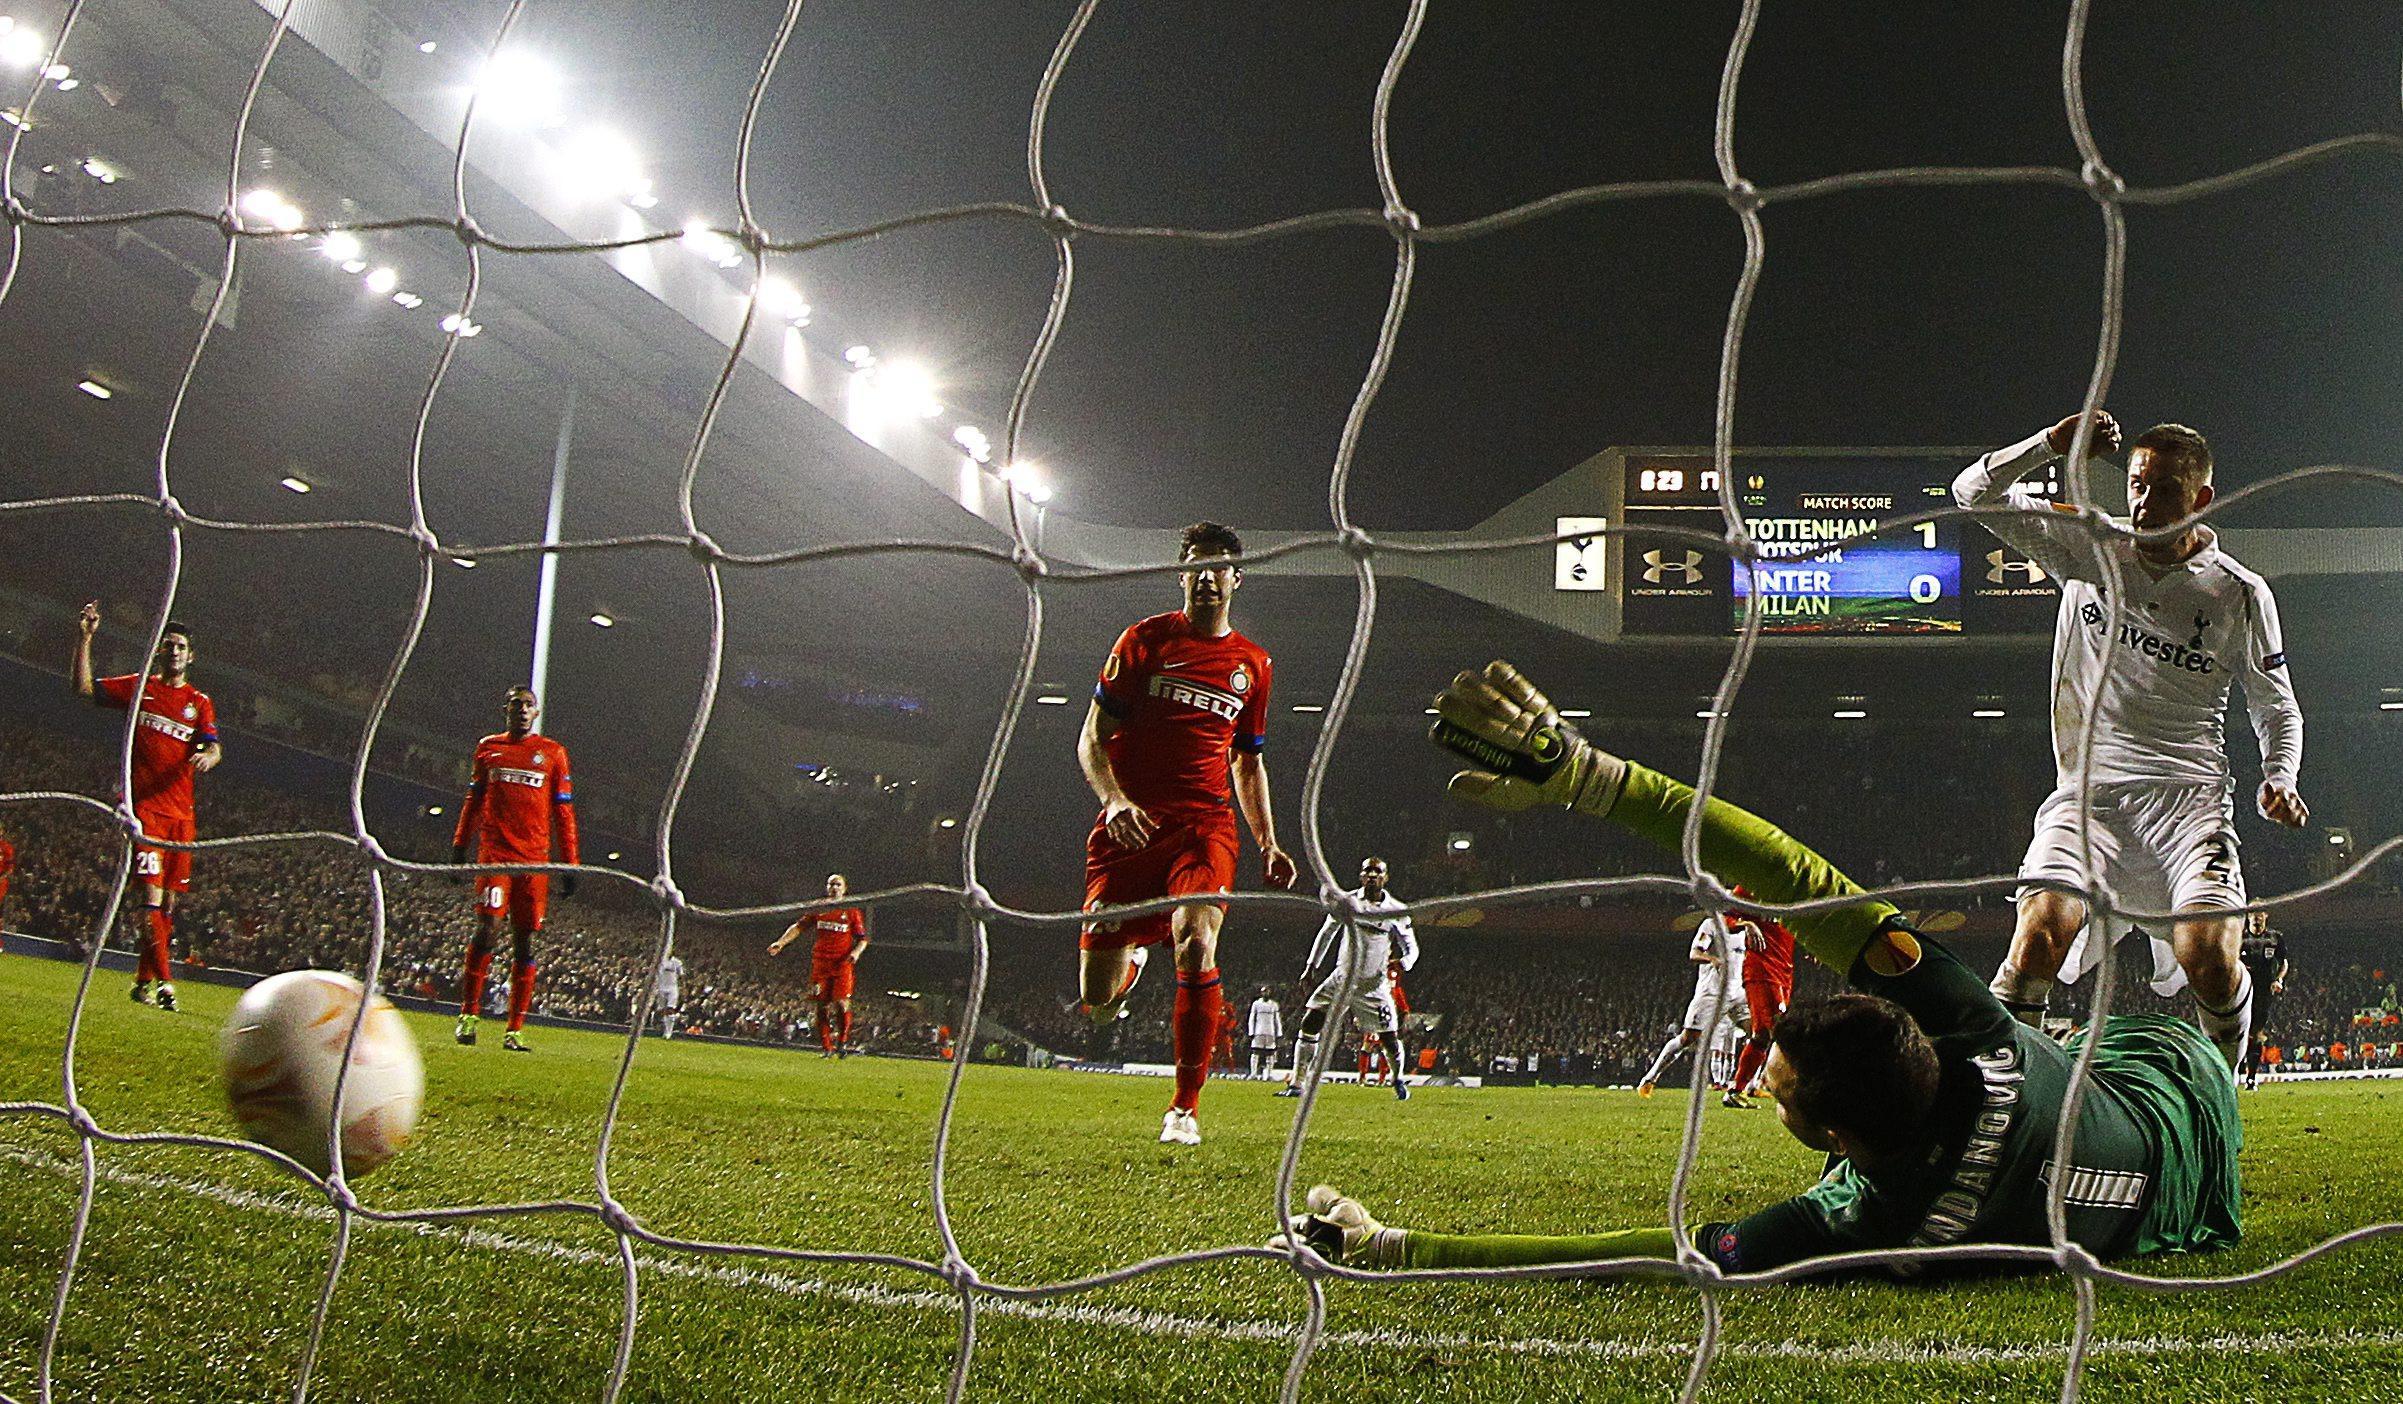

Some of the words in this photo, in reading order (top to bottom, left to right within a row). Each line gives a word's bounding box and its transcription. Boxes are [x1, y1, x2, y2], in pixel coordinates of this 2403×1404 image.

[1803, 497, 1849, 509] MATCH
[1852, 497, 1892, 509] SCORE
[1745, 518, 1877, 540] TOTTENHAM
[1913, 520, 1937, 548] 1
[1909, 574, 1941, 604] 0
[1974, 588, 2010, 597] UNDER
[2011, 588, 2056, 597] ARMOUR
[1757, 594, 1830, 615] MILAN
[136, 851, 160, 875] 26
[1892, 1045, 2026, 1270] NDANOVIC
